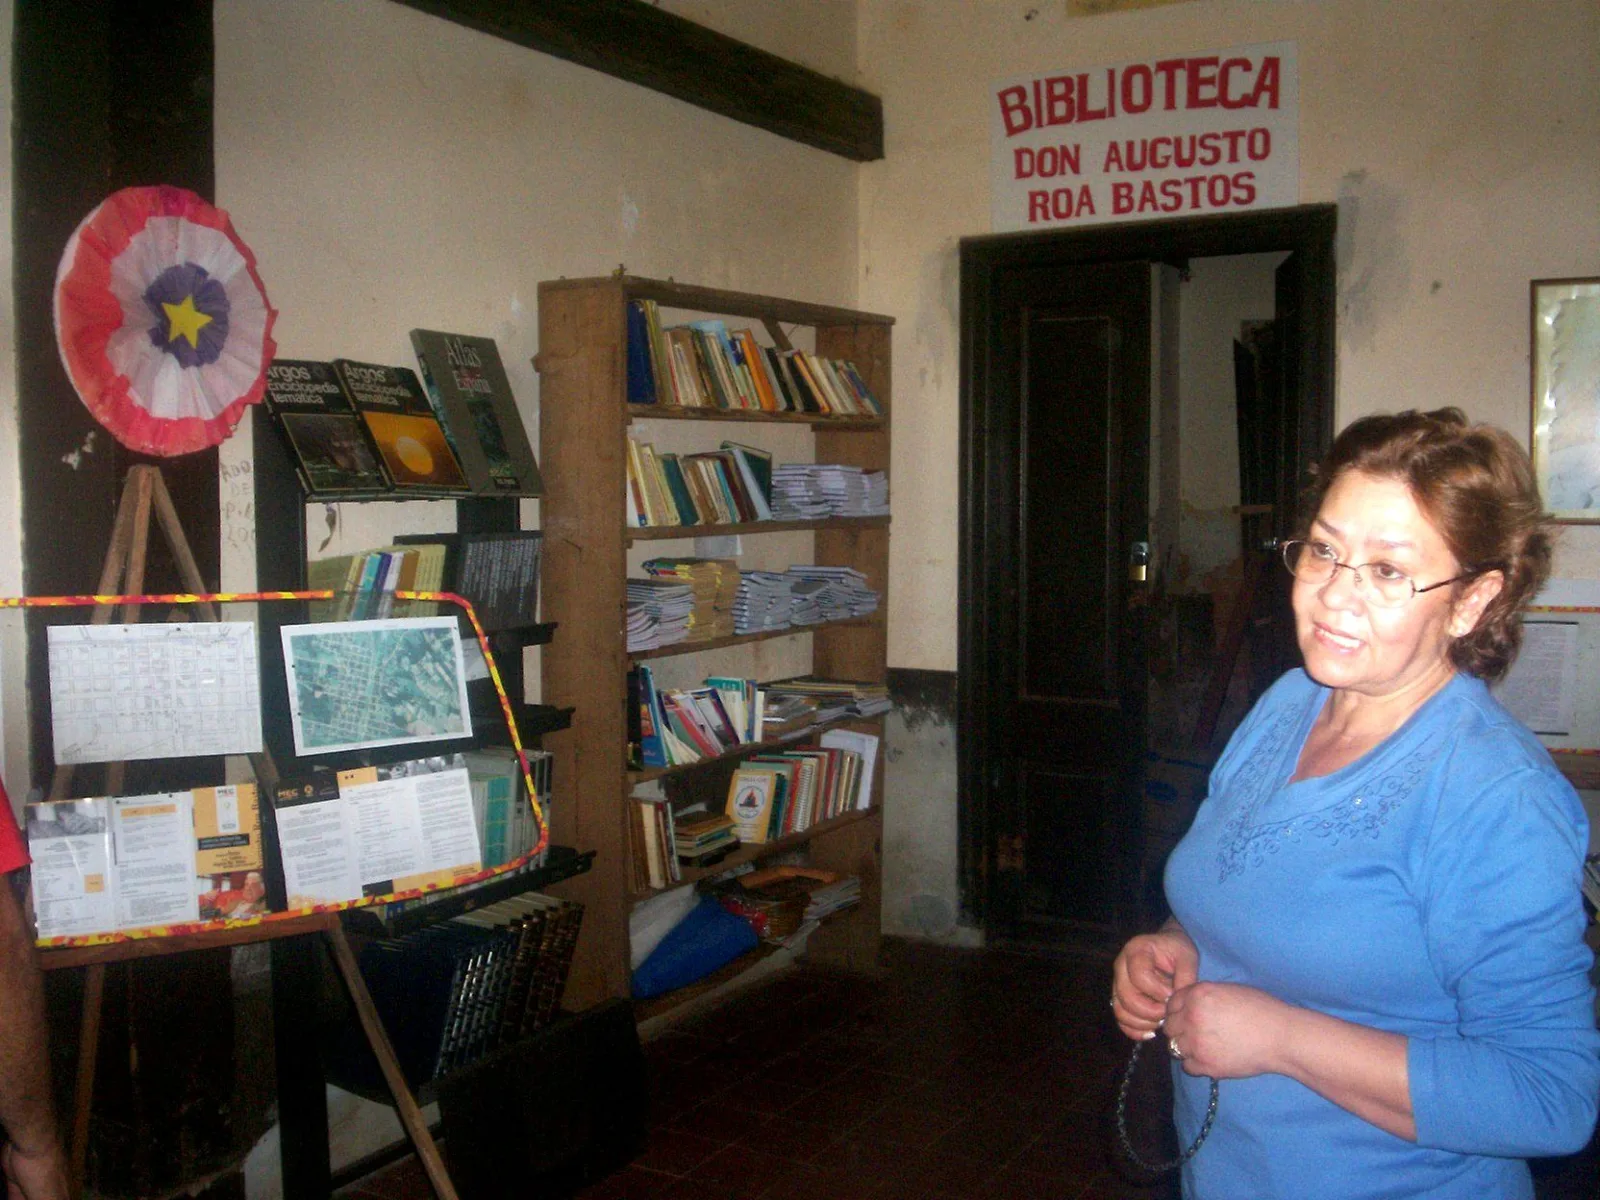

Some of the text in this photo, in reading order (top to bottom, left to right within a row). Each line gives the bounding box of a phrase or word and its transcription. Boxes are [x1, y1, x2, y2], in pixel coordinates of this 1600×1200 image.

[997, 56, 1281, 137] BIBLIOTECA
[1013, 127, 1272, 180] DON AUGUSTO
[1028, 171, 1257, 223] ROA BASTOS
